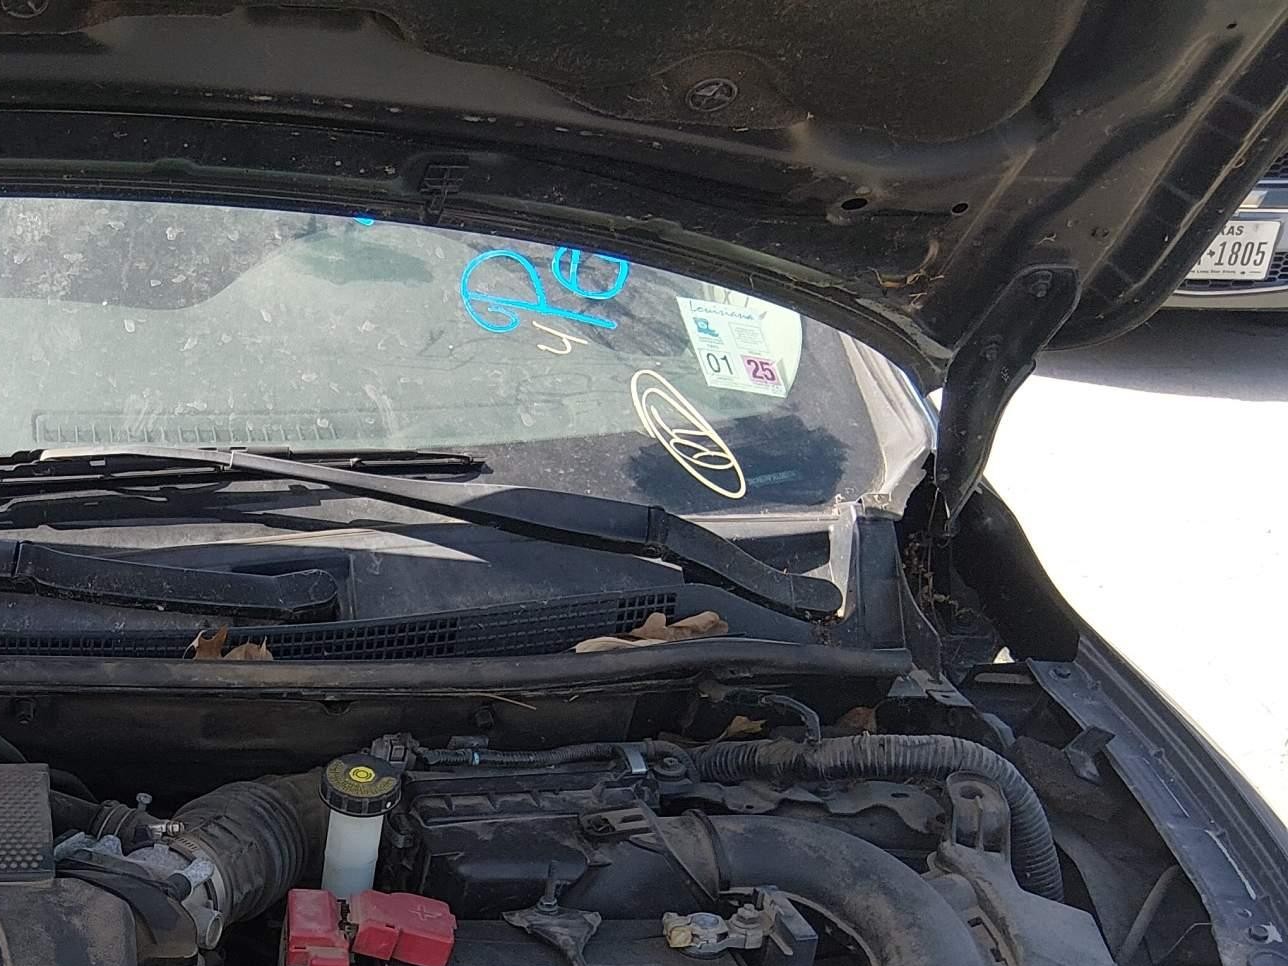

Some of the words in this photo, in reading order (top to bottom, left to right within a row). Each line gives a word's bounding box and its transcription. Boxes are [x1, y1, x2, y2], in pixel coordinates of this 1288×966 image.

[1214, 241, 1268, 266] 1805
[689, 299, 755, 321] Louisiana
[706, 352, 733, 375] 01
[746, 359, 776, 382] 25
